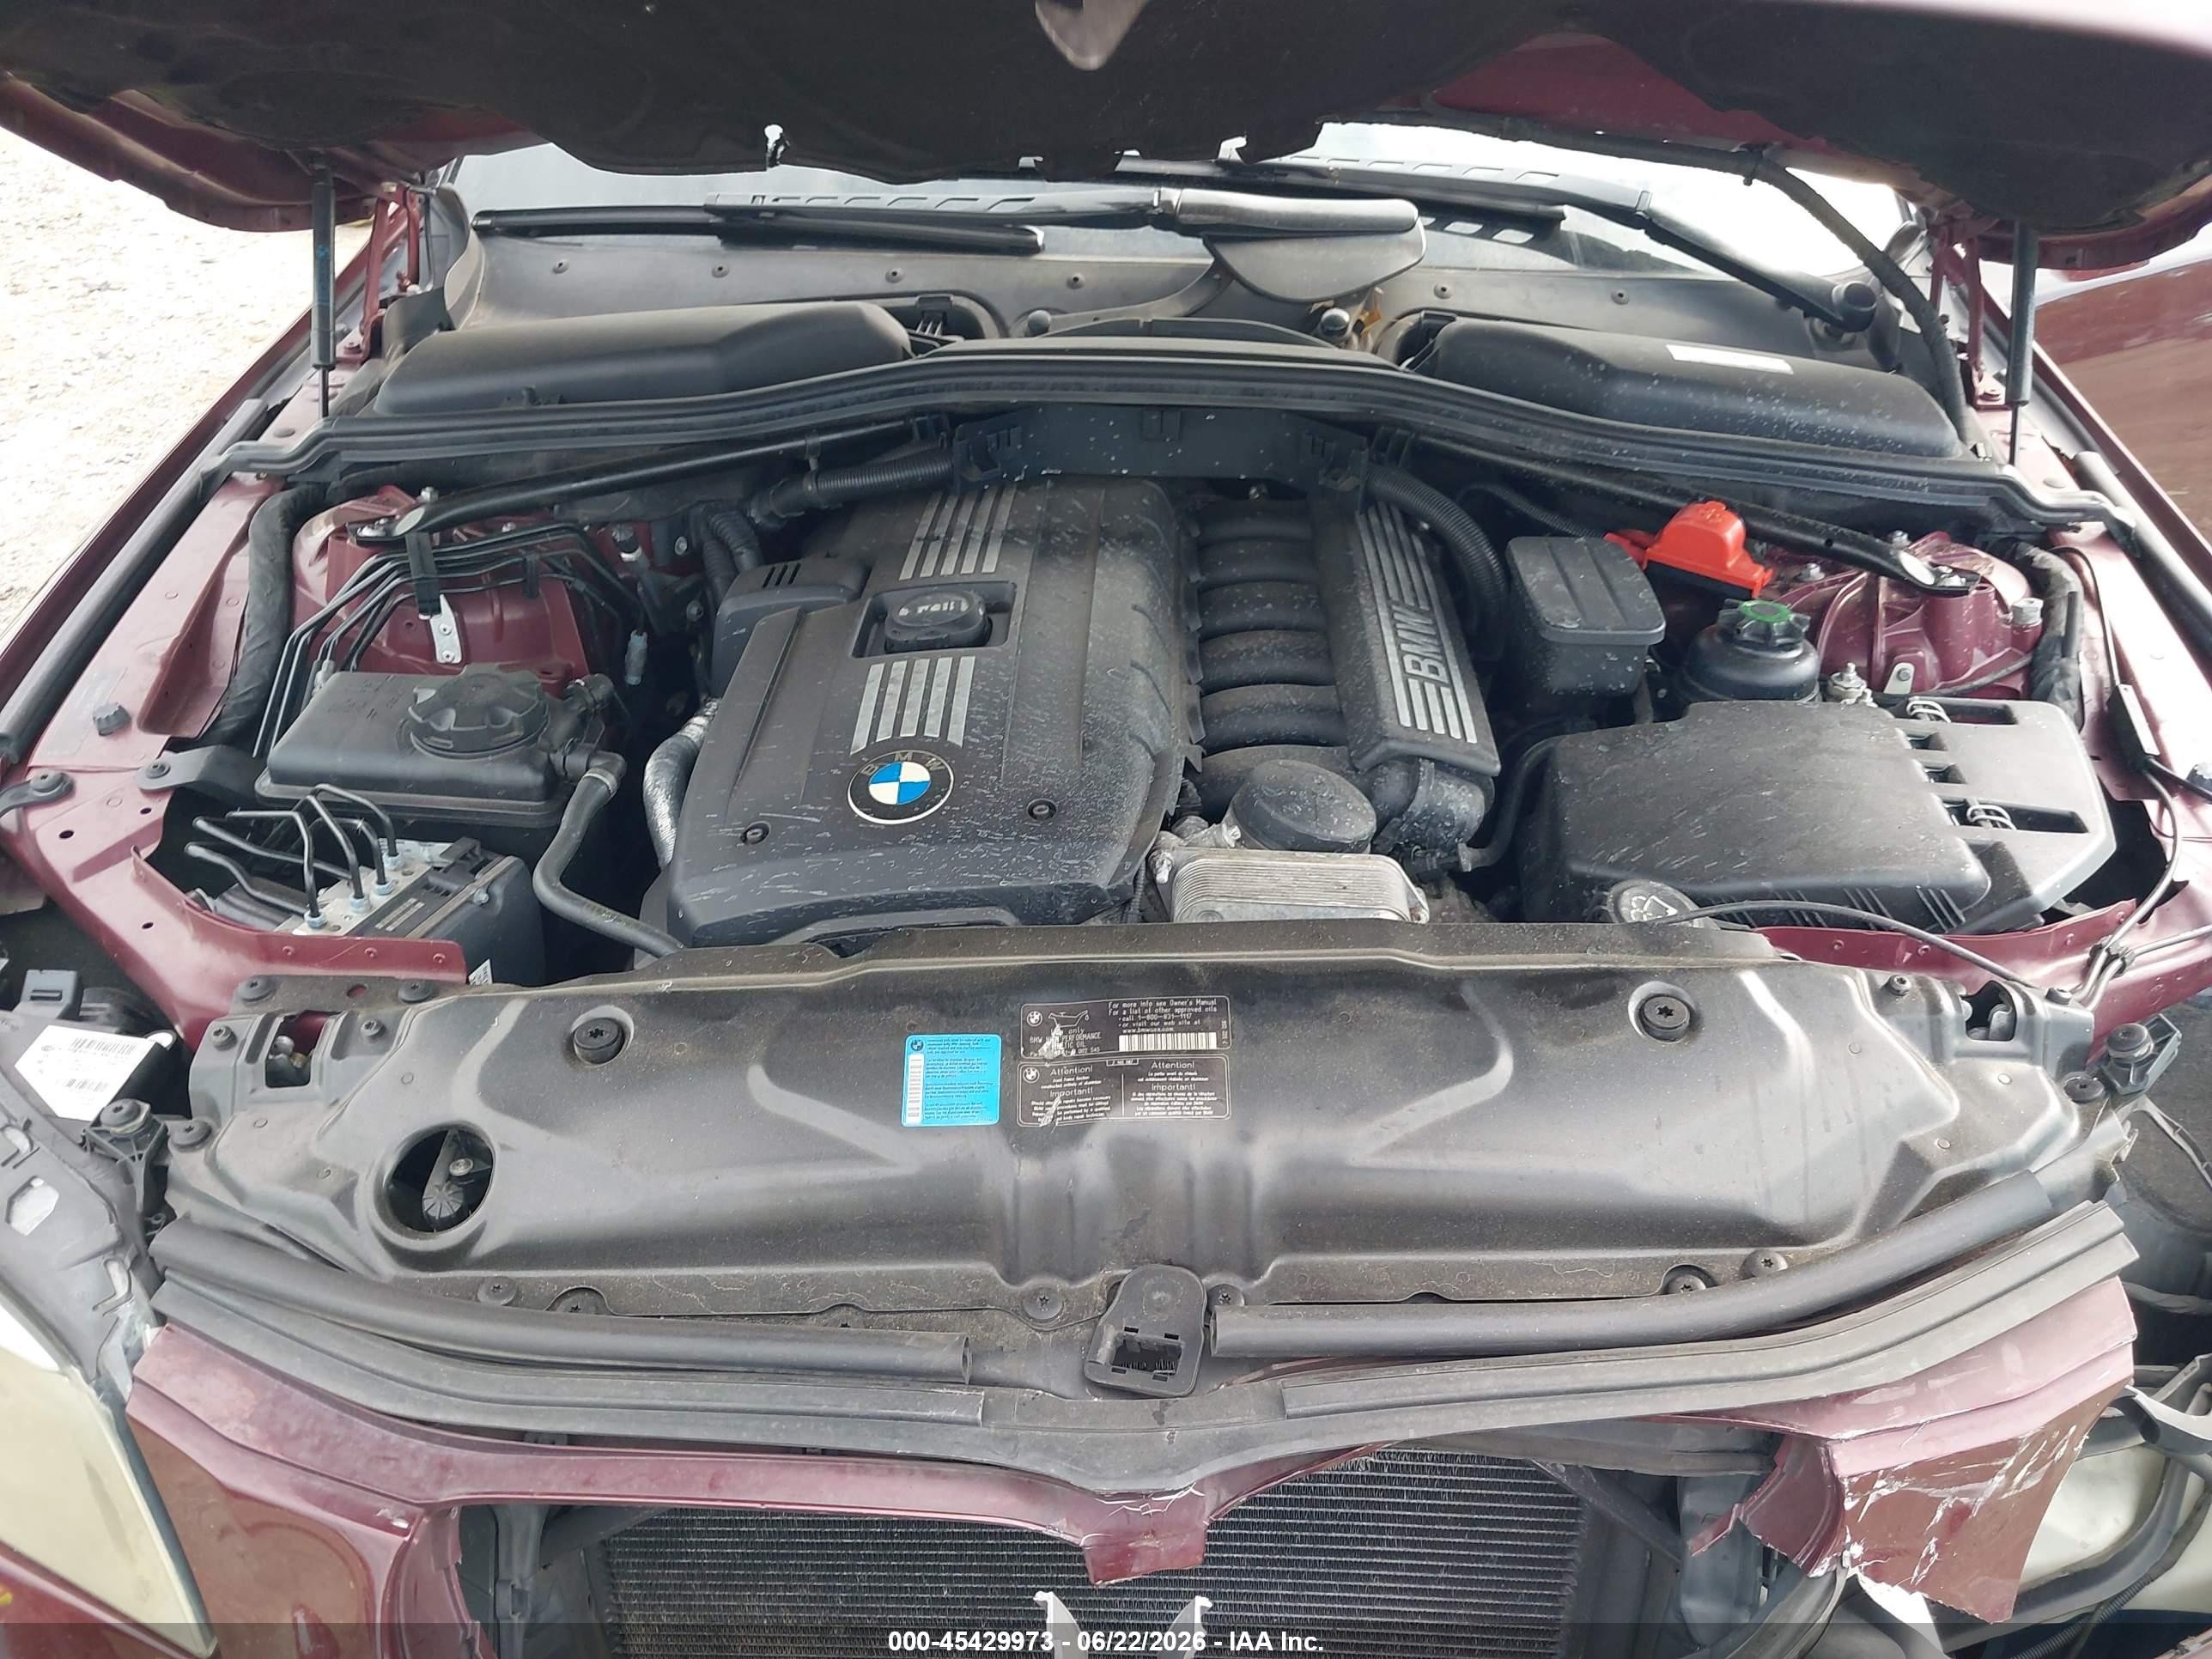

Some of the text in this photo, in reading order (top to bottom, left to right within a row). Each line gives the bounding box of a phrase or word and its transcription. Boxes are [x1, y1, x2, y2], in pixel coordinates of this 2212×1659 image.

[1392, 605, 1449, 684] BMW
[860, 751, 945, 776] BMW
[1068, 1026, 1085, 1035] only
[1061, 1031, 1102, 1042] PERFORMANCE
[1151, 1060, 1195, 1070] Attention!
[1049, 1065, 1093, 1077] Attention!
[1049, 1086, 1093, 1098] Important!
[1152, 1083, 1195, 1091] Important!
